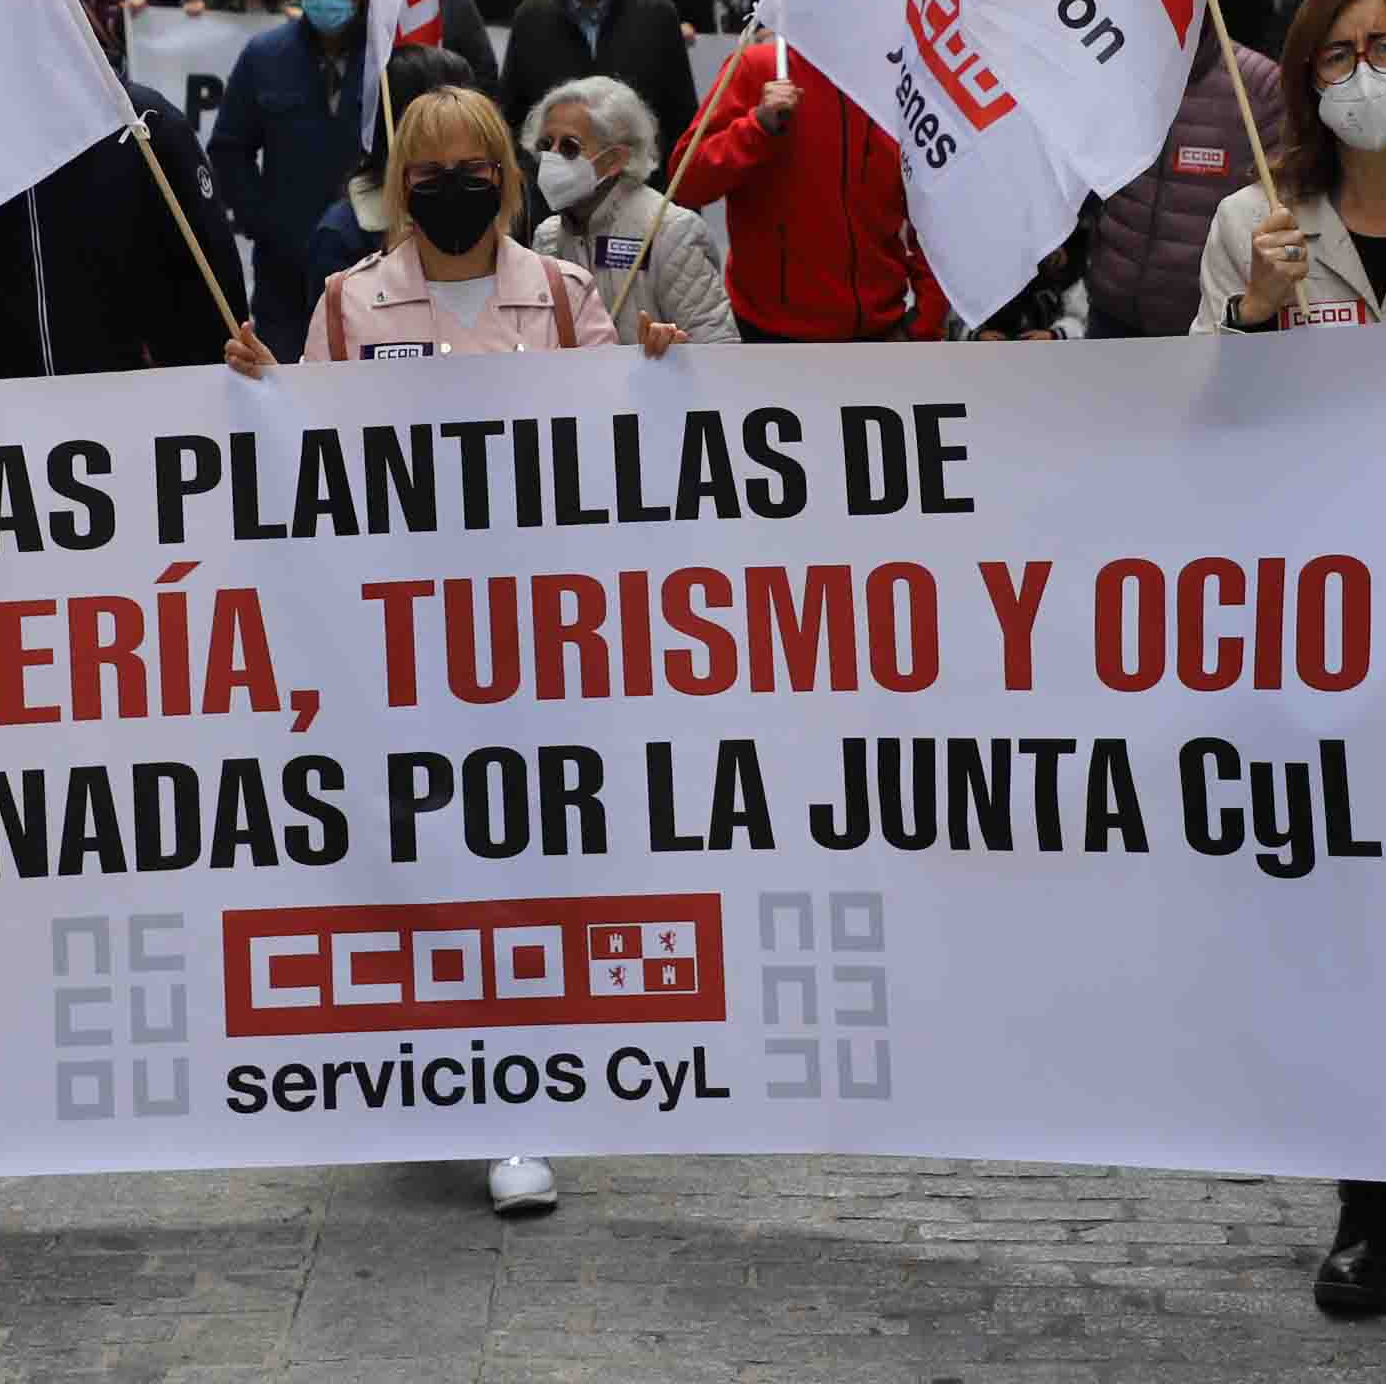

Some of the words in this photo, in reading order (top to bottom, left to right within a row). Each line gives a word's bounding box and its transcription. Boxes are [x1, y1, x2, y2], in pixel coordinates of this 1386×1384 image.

[377, 348, 420, 360] CCOO
[1293, 308, 1352, 327] CCOO
[155, 405, 808, 545] PLANTILLAS
[840, 402, 976, 516] DE
[361, 560, 940, 708] TURISMO
[978, 560, 1054, 691] Y
[1094, 554, 1372, 692] OCIO
[388, 744, 608, 863] POR
[646, 738, 776, 853] LA
[809, 737, 1151, 853] JUNTA
[1178, 737, 1383, 879] CyL
[249, 924, 566, 1009] CCOO
[225, 1040, 587, 1114] servicios
[606, 1046, 732, 1112] CyL
